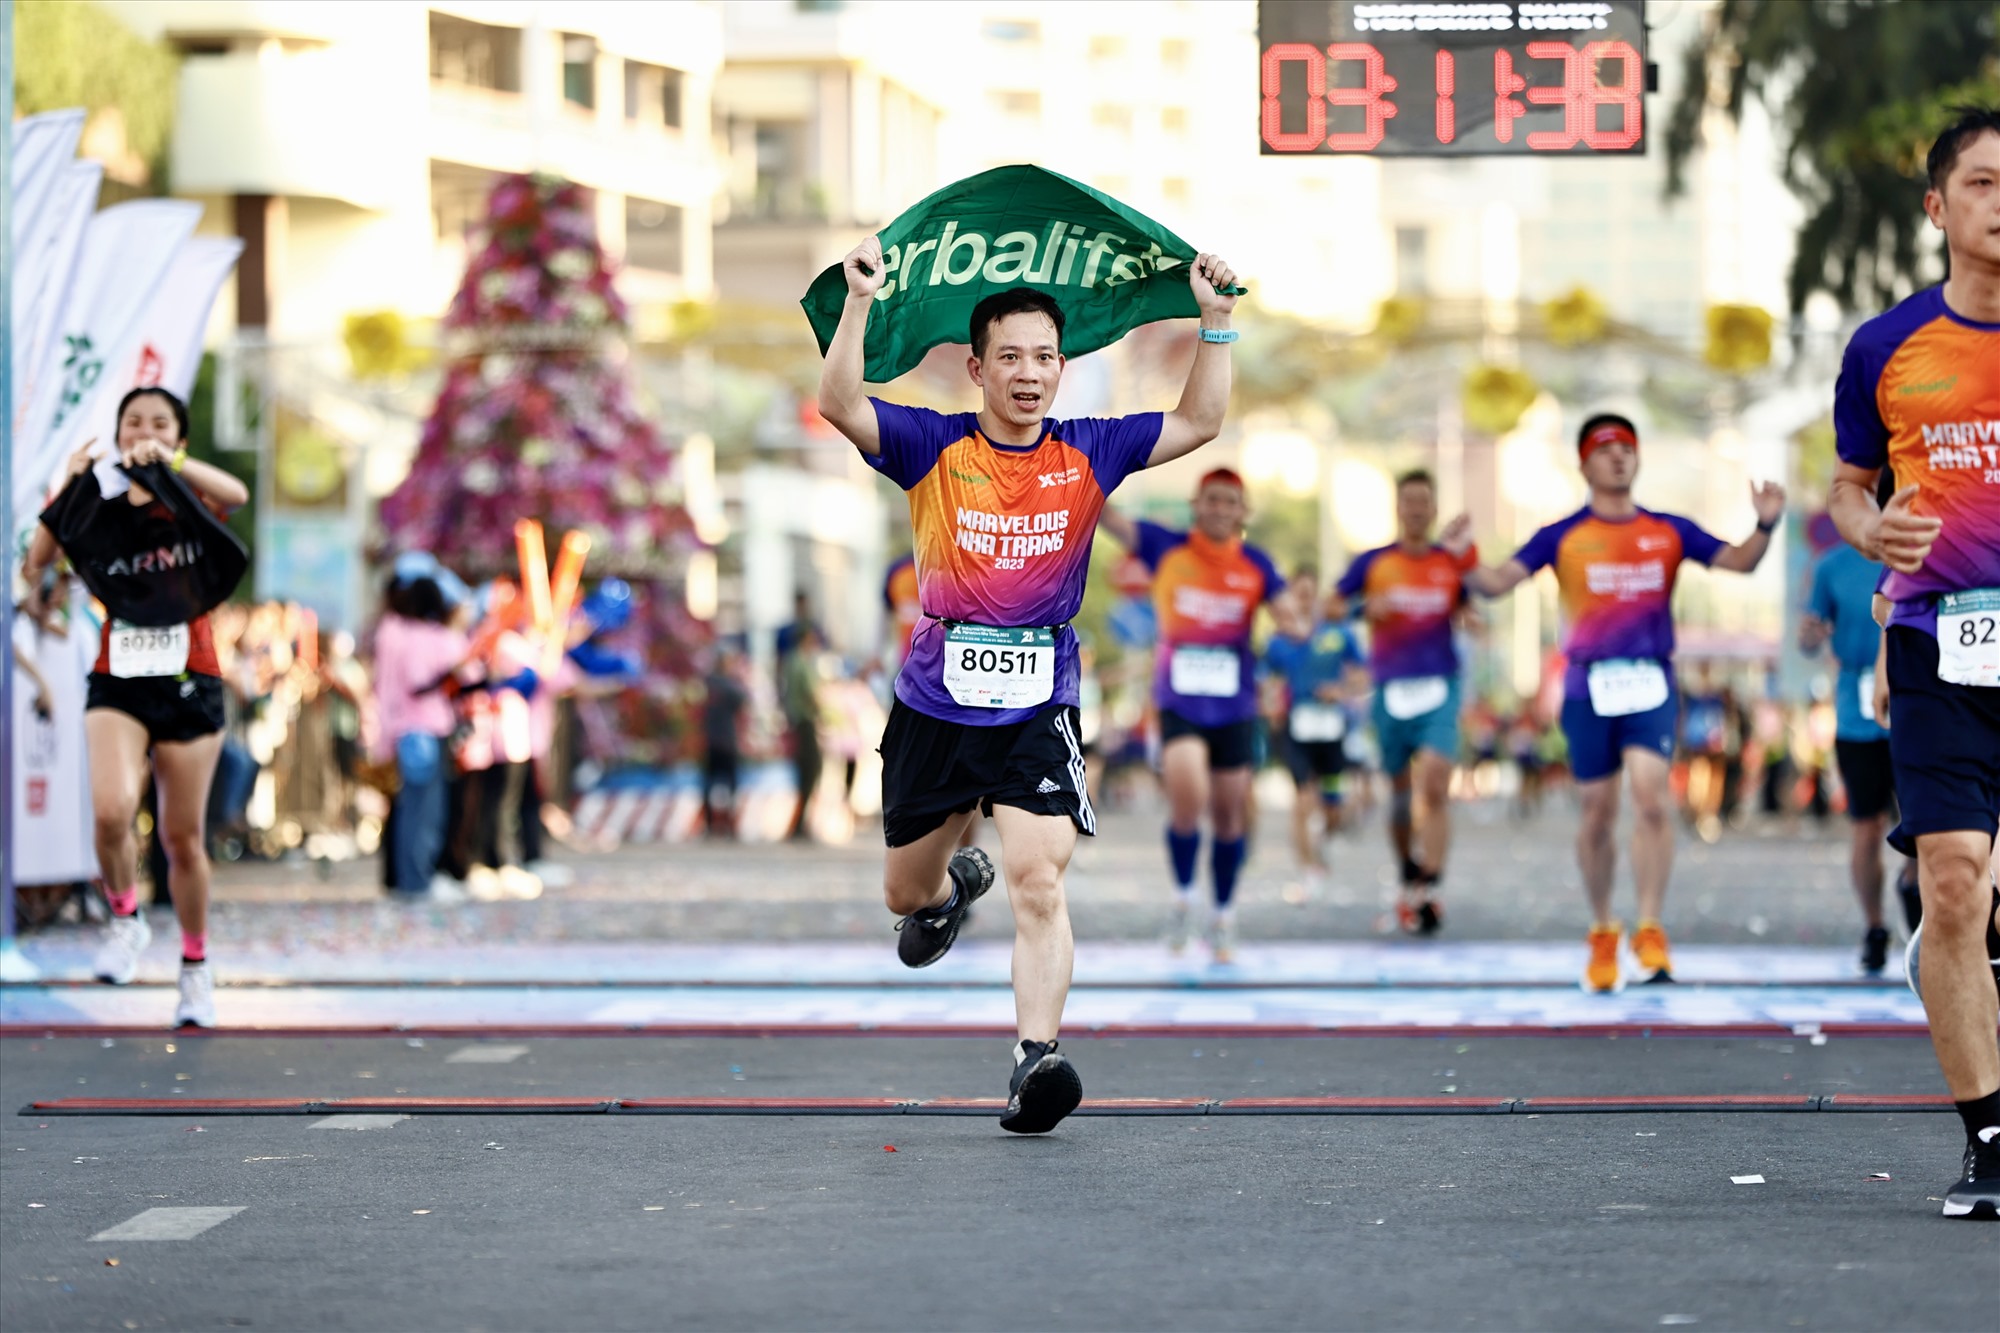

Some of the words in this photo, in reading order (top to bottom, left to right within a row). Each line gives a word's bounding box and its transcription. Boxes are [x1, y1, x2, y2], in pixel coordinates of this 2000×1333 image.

[874, 221, 1148, 301] erbalife
[957, 506, 1069, 534] MARVELOUS
[956, 527, 997, 556] NHA
[999, 530, 1065, 557] TRANG
[107, 542, 203, 576] ARMI
[994, 557, 1025, 570] 2023
[1959, 617, 2000, 646] 82
[961, 648, 1037, 674] 80511
